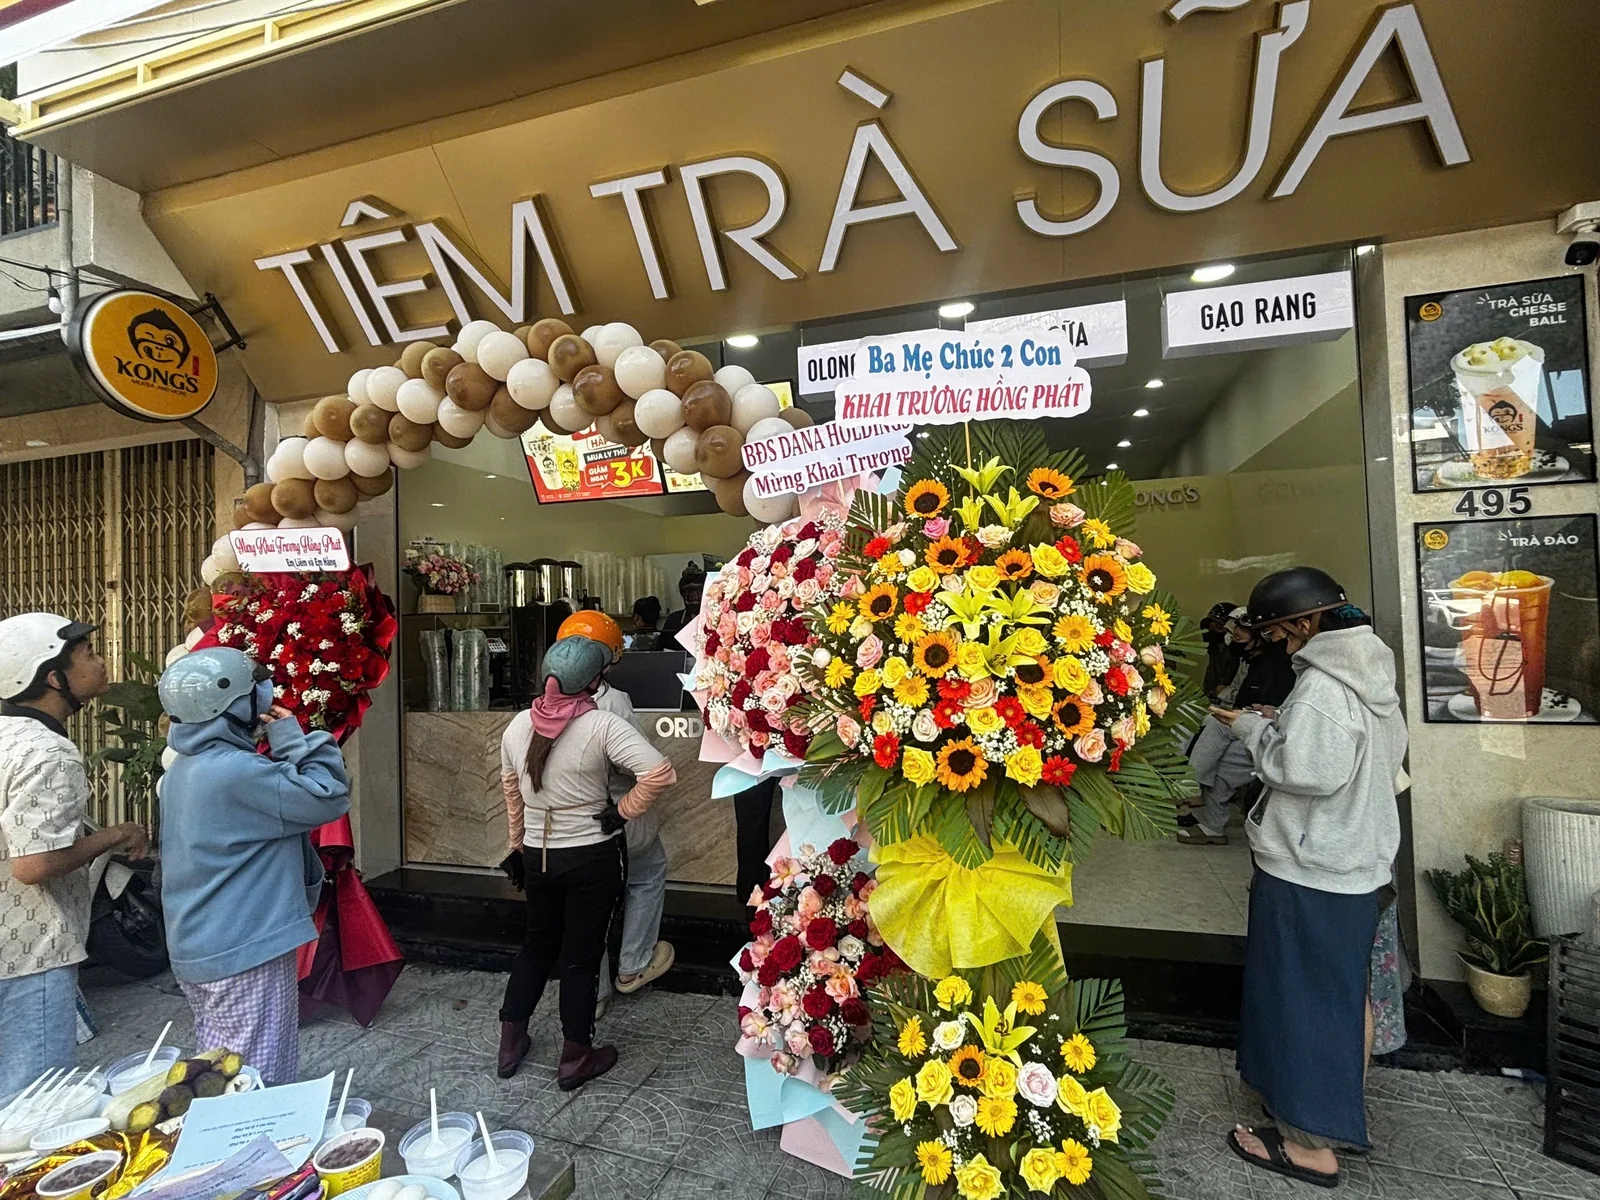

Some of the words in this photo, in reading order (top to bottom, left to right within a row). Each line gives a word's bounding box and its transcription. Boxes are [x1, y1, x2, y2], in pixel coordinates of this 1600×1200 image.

[589, 68, 960, 300] TRÀ
[1016, 0, 1472, 237] SỮA
[1200, 300, 1244, 332] GẠO
[1255, 292, 1316, 324] RANG
[1488, 296, 1519, 310] TRÀ
[1522, 292, 1554, 306] SỮA
[1509, 302, 1567, 317] CHESSE
[1529, 314, 1567, 327] BALL
[868, 345, 896, 374] Ba
[902, 343, 932, 379] Mẹ
[940, 340, 994, 370] Chúc
[1000, 344, 1013, 368] 2
[1020, 339, 1062, 367] Con
[114, 355, 199, 394] KONG'S
[842, 392, 892, 420] KHAI
[896, 385, 972, 416] TRƯƠNG
[976, 374, 1028, 412] HỒNG
[1032, 376, 1084, 409] PHÁT
[586, 452, 604, 462] MUA
[604, 450, 612, 459] LY
[744, 438, 777, 468] BĐS
[778, 426, 825, 460] DANA
[590, 474, 608, 483] NGAY
[755, 472, 804, 496] Mừng
[805, 457, 844, 484] Khai
[846, 446, 912, 474] Trương
[1454, 488, 1531, 518] 495
[256, 537, 276, 554] Khai
[322, 534, 342, 553] Phát
[1510, 534, 1540, 546] TRÀ
[1543, 534, 1579, 546] ĐÀO
[656, 716, 704, 738] ORD
